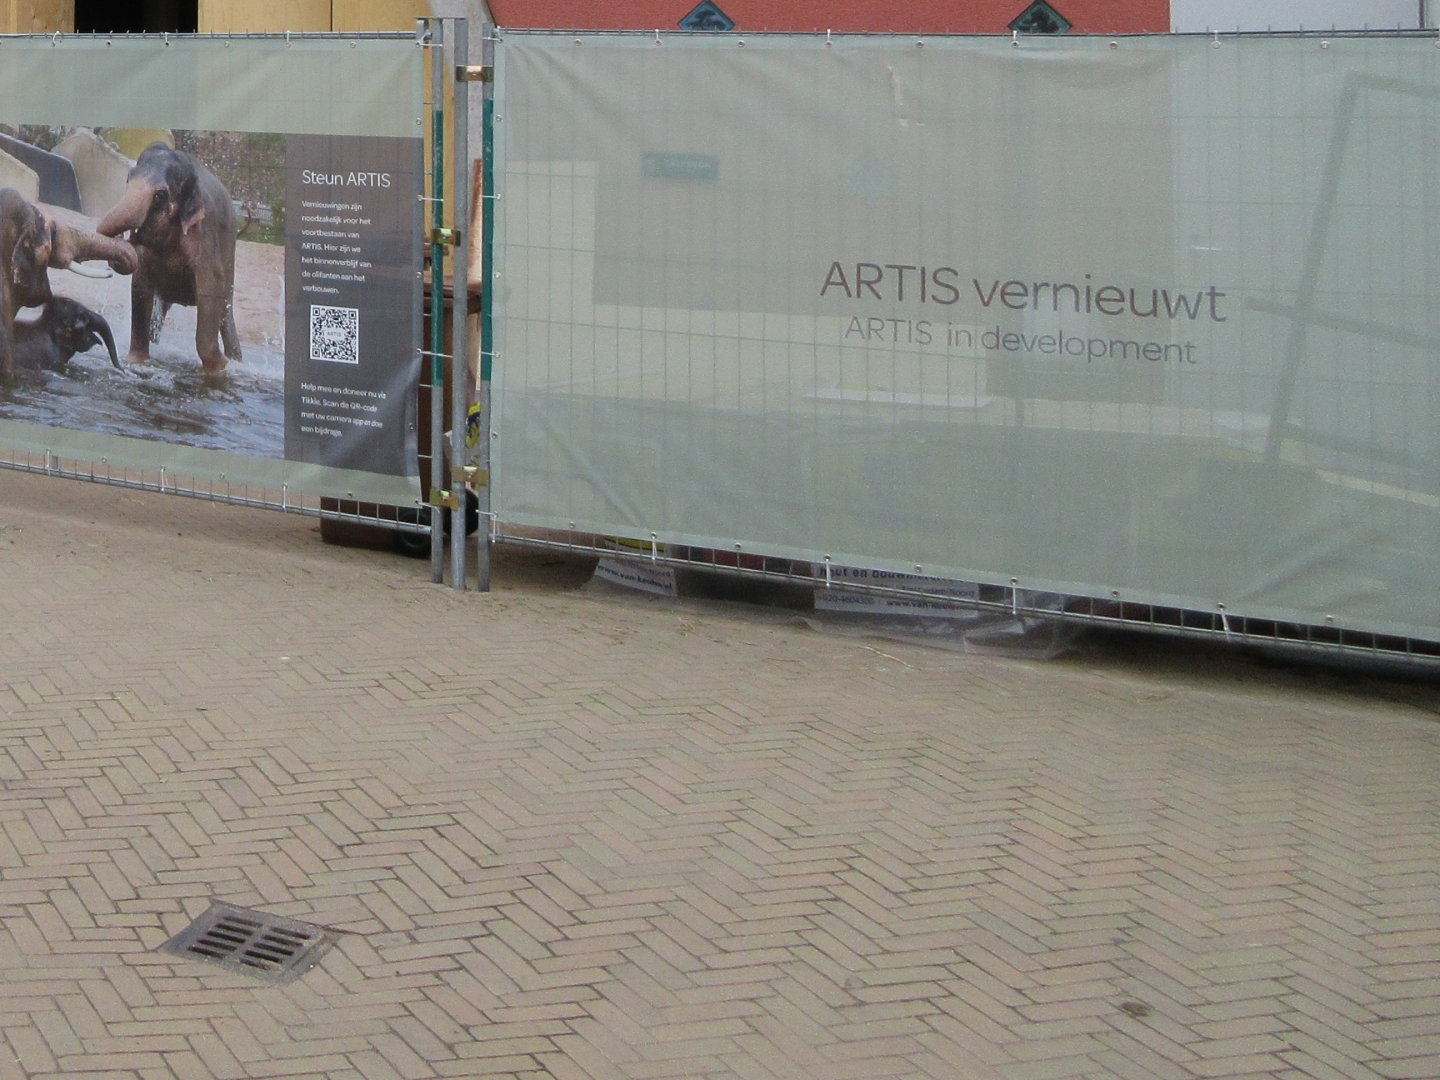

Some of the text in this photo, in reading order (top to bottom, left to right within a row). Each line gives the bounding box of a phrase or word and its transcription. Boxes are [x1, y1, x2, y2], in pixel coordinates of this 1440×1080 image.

[302, 169, 391, 188] Steun ARTIS
[302, 200, 362, 212] Vernieuwingen zijn
[302, 214, 342, 225] noodzakelijk
[302, 229, 346, 238] voortbestaan
[302, 242, 322, 250] ARTIS.
[324, 244, 338, 252] Hier
[339, 244, 351, 254] zijn
[302, 256, 313, 264] het
[314, 258, 358, 268] binnenverblijf
[302, 270, 310, 278] de
[312, 270, 340, 280] olifanten
[354, 274, 366, 282] het
[302, 284, 340, 294] verbouwen.
[819, 261, 1228, 323] ARTIS vernieuwt
[844, 316, 1198, 365] ARTIS in development
[301, 382, 316, 392] Help
[343, 388, 368, 396] doneer
[302, 396, 322, 406] Tikkie.
[322, 400, 340, 408] Scan
[350, 402, 378, 412] QR-code
[301, 412, 314, 420] met
[314, 426, 342, 437] bijdrage.
[852, 568, 867, 578] en
